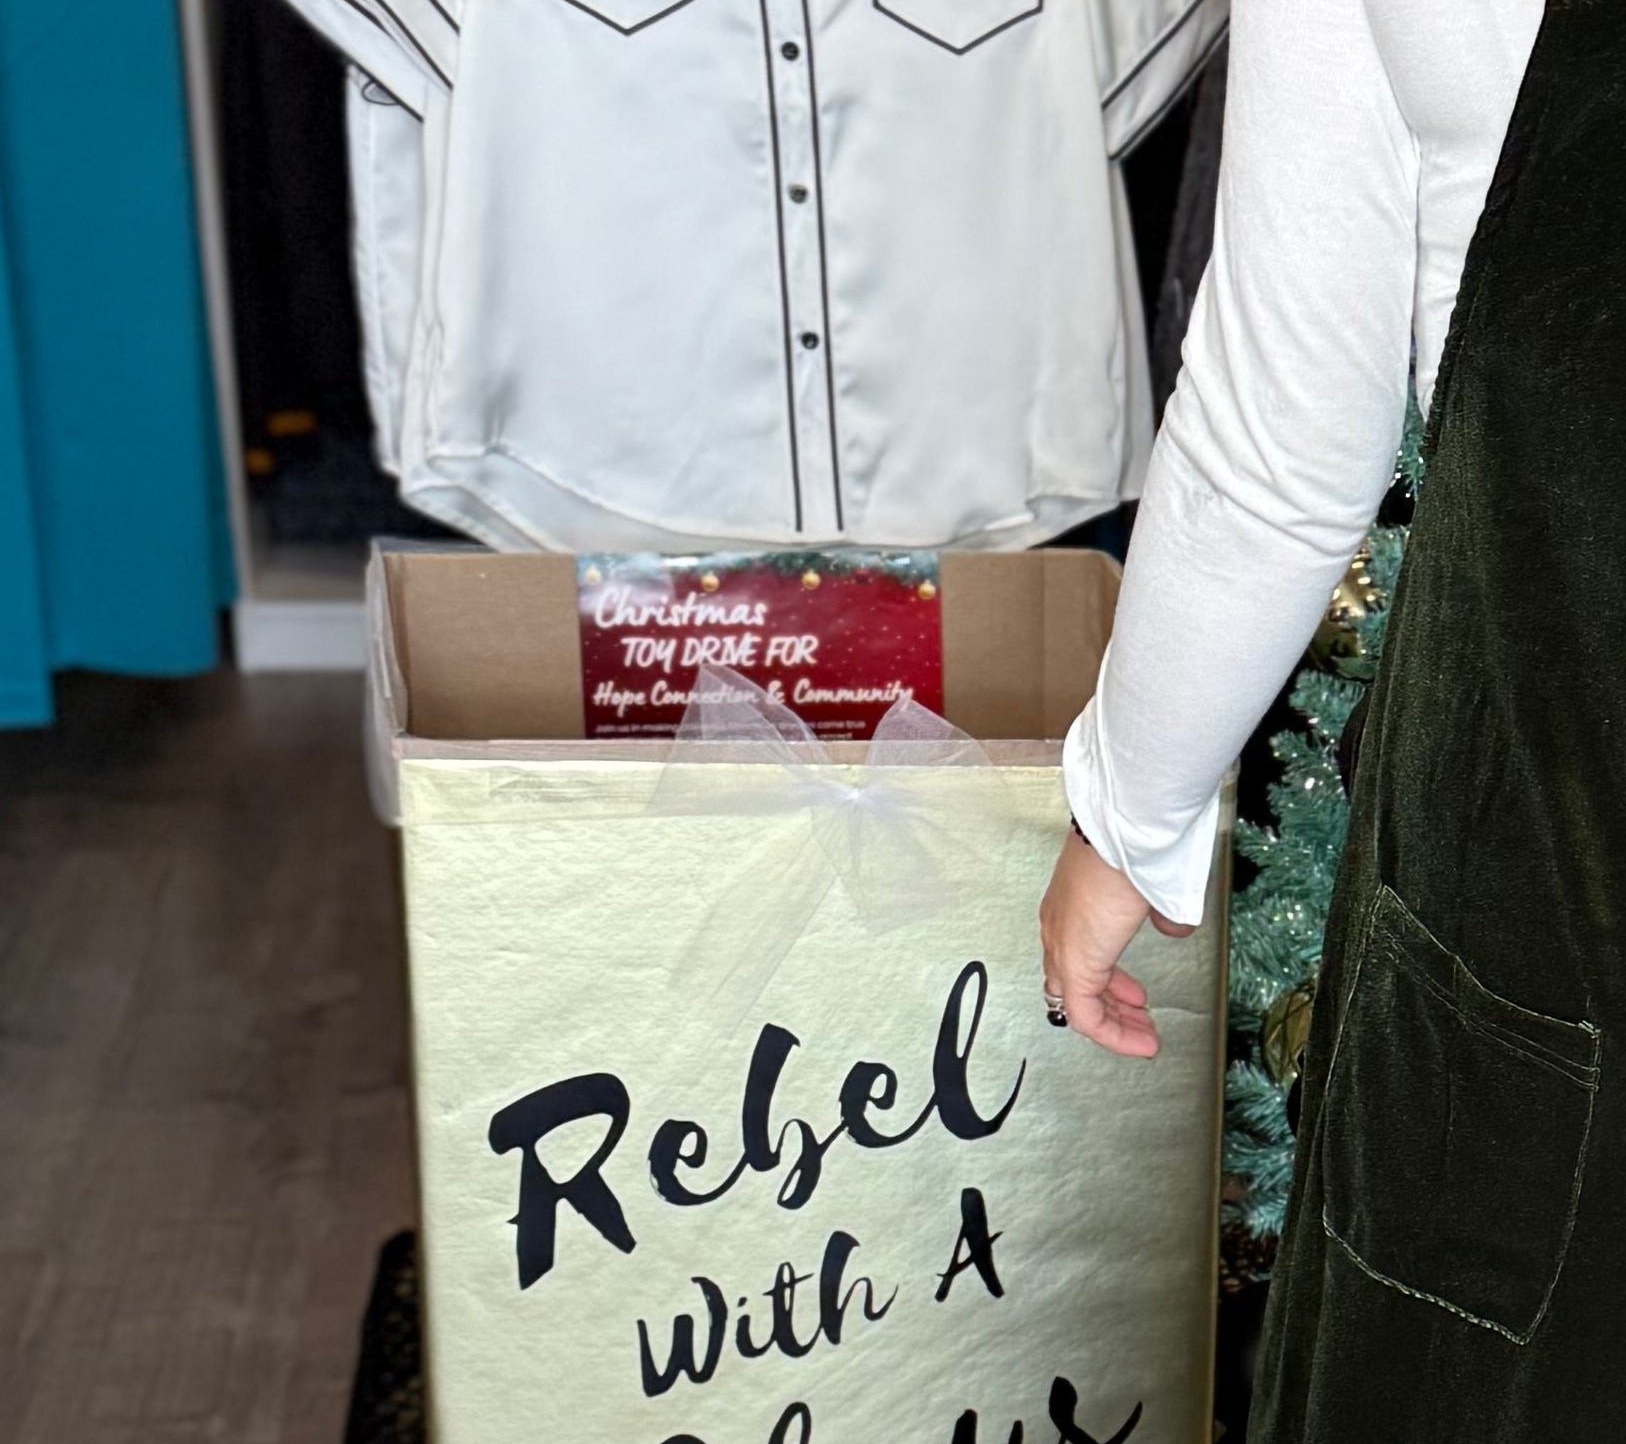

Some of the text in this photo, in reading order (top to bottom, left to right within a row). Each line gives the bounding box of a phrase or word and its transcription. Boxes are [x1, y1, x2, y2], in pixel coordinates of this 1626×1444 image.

[594, 586, 768, 629] Christmas
[621, 633, 820, 674] TOY DRIVE FOR
[592, 680, 646, 718] Hope
[765, 679, 785, 705] &
[793, 678, 914, 712] Community
[488, 960, 1027, 1290] Rebel
[935, 1187, 1005, 1303] A
